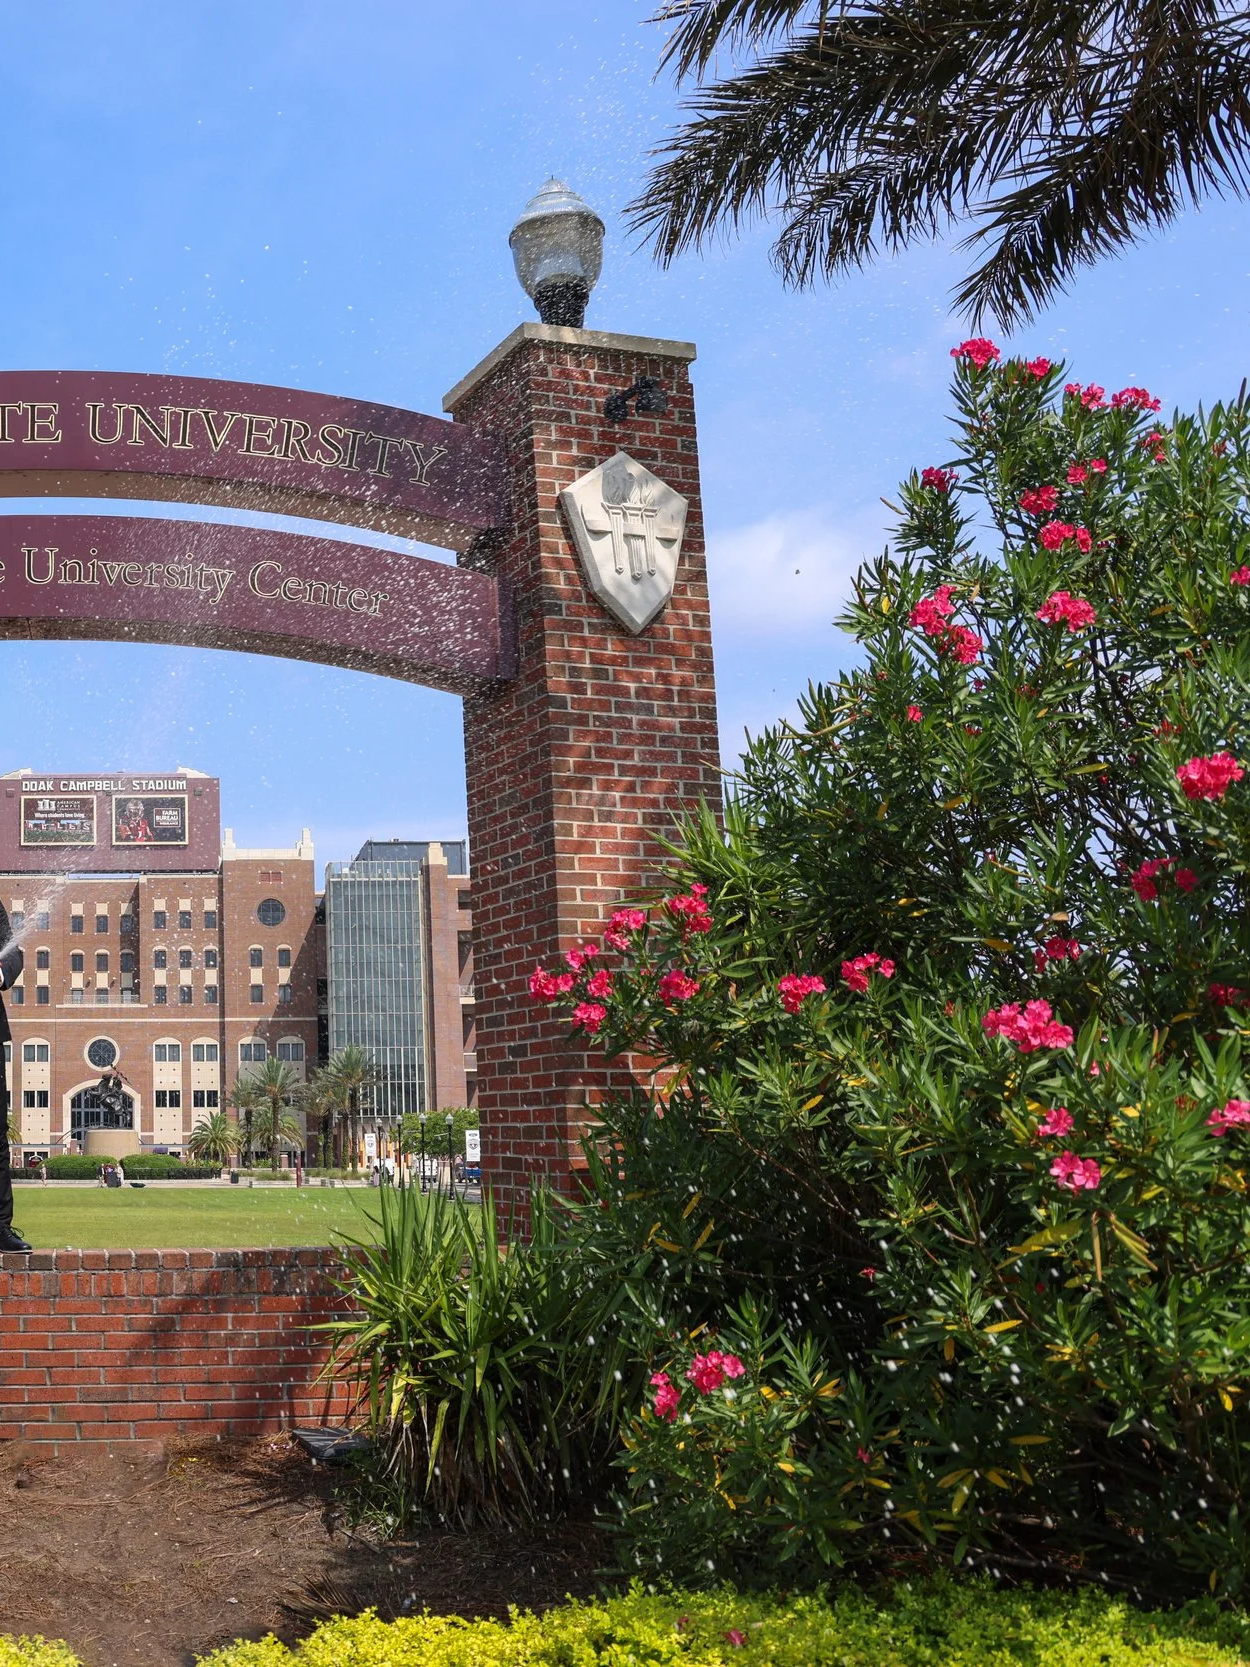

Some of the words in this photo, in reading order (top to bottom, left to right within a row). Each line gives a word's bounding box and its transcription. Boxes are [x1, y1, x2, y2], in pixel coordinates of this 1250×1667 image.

[86, 402, 448, 486] UNIVERSITY
[21, 547, 235, 604] University
[248, 560, 389, 617] Center
[22, 780, 54, 792] DOAK
[60, 780, 126, 792] CAMPBELL
[132, 779, 188, 791] STADIUM
